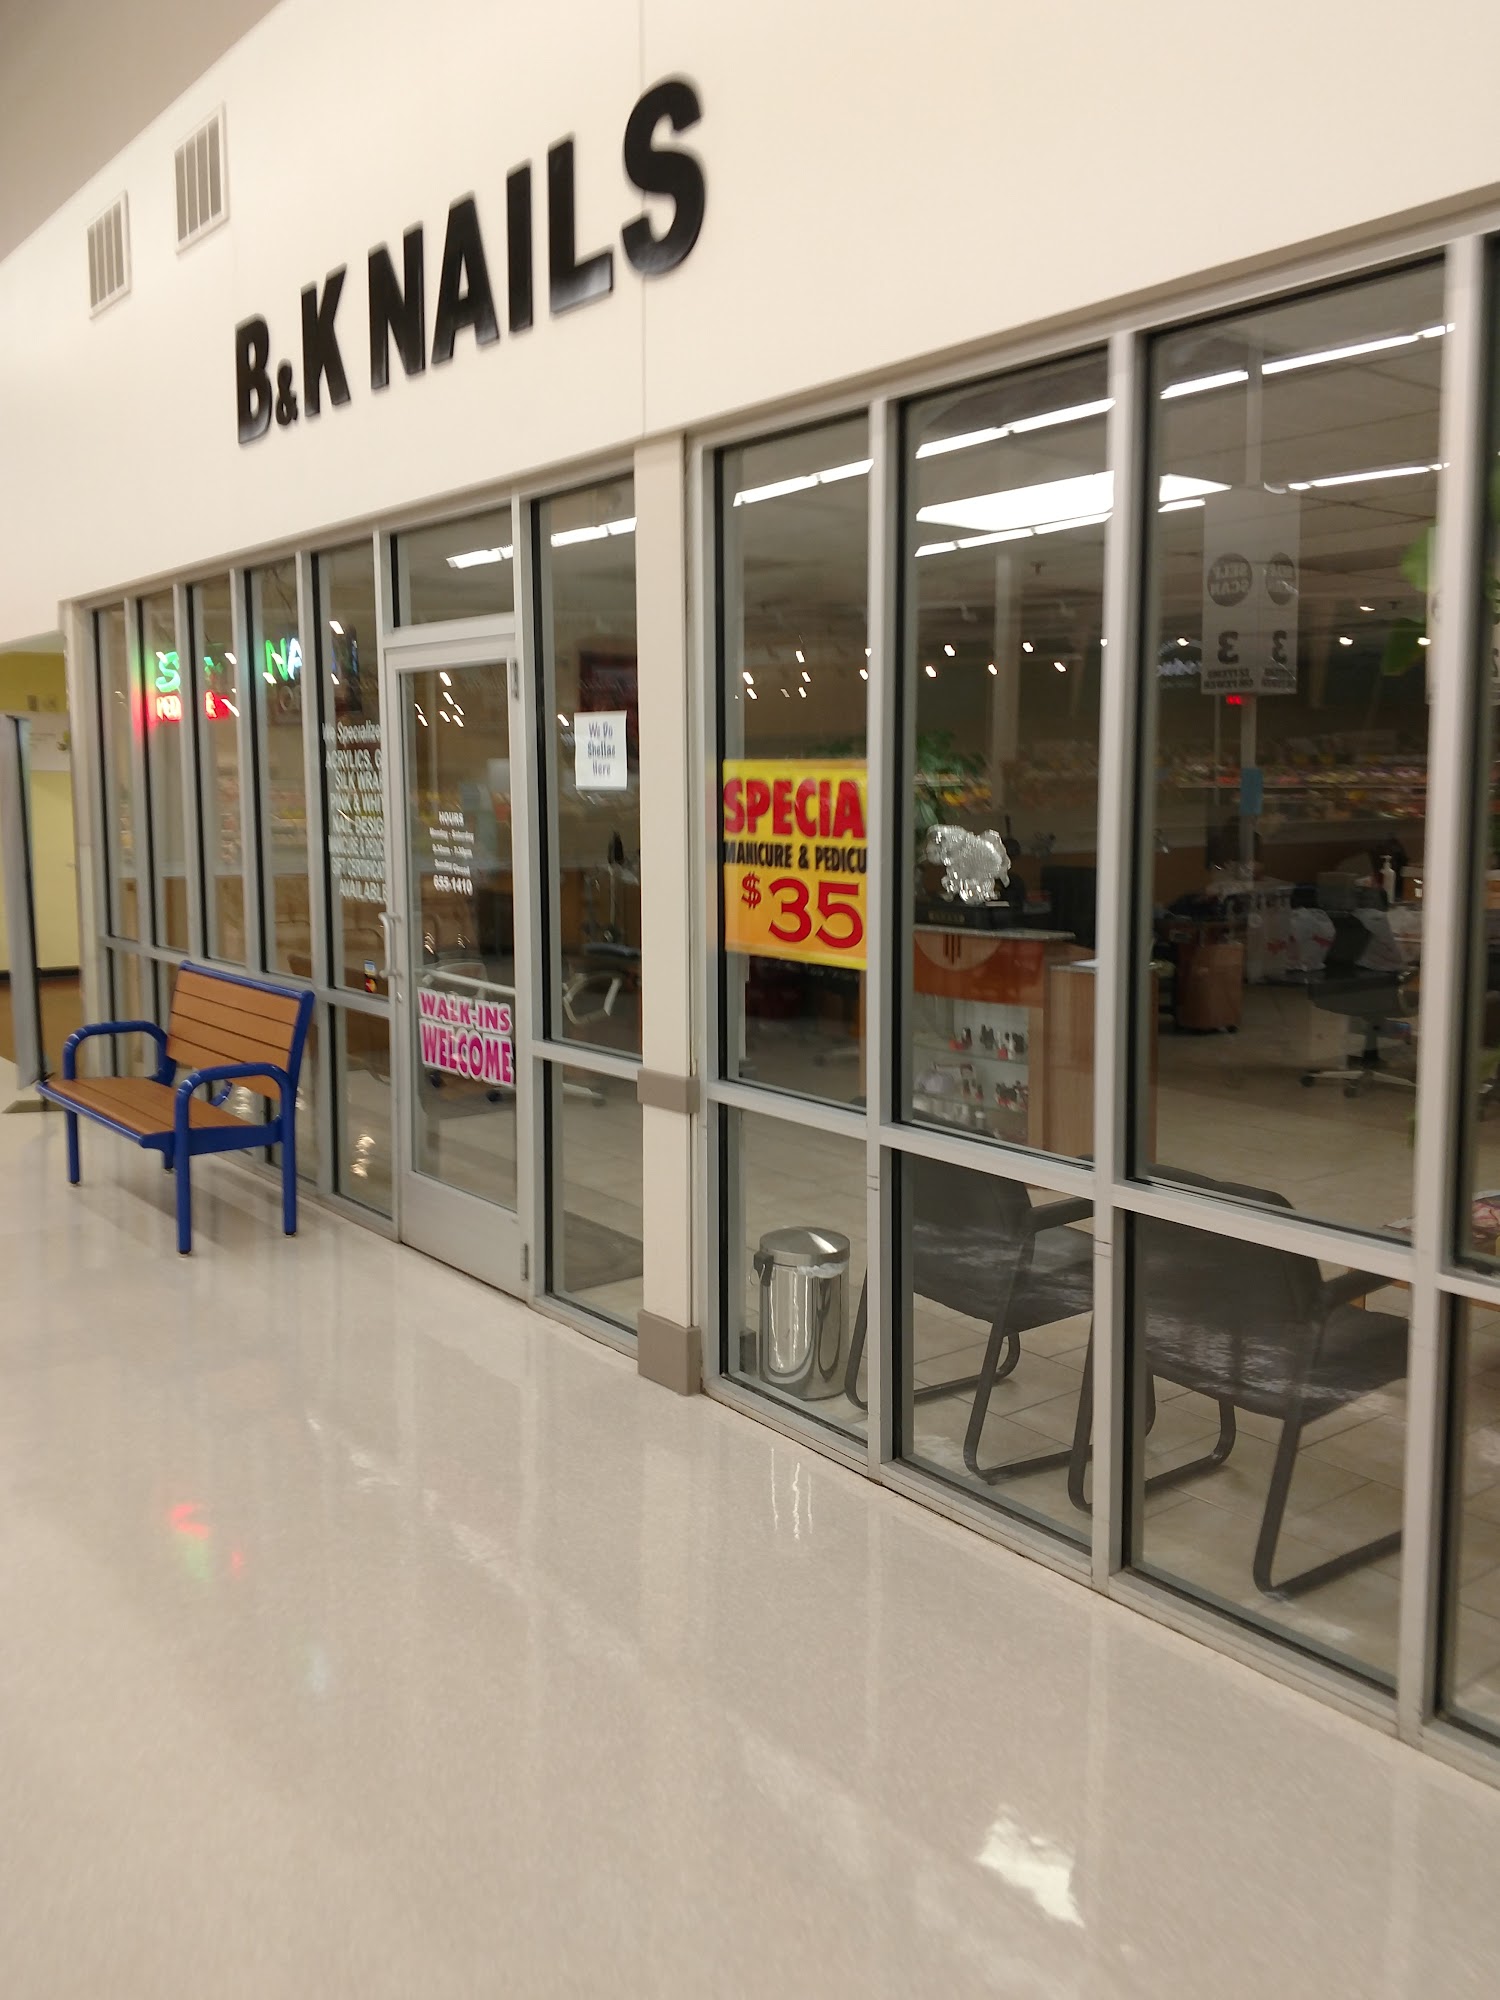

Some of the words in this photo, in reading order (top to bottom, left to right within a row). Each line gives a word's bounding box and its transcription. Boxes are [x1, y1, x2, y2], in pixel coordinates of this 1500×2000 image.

[235, 262, 352, 445] B&K
[367, 72, 707, 392] NAILS
[588, 721, 600, 739] We
[602, 721, 613, 739] Do
[592, 760, 611, 777] Here
[438, 810, 464, 828] HOURS
[723, 777, 867, 839] SPECIA
[723, 839, 793, 869] MANICURE
[798, 844, 809, 870] &
[420, 990, 511, 1033] WALK-INS
[421, 1022, 512, 1083] WELCOME
